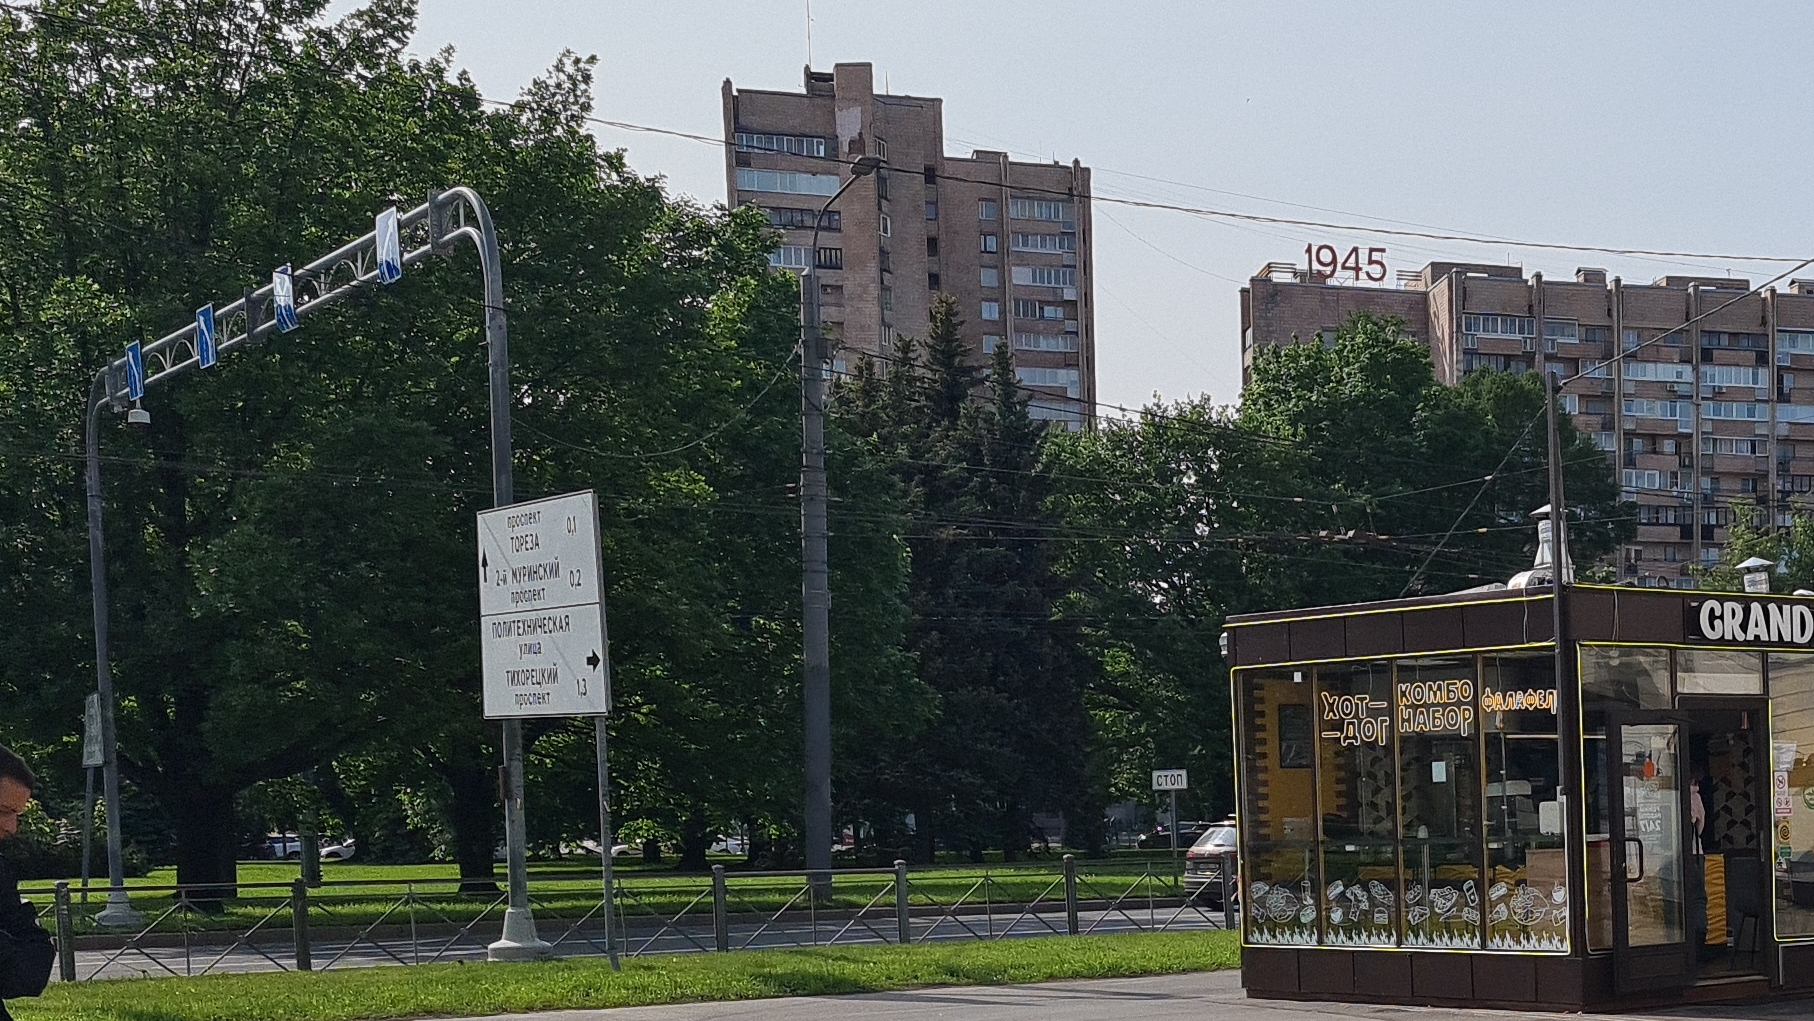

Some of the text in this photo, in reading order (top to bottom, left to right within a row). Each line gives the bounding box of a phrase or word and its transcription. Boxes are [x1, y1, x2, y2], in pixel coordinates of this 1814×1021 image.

[1305, 242, 1387, 283] 1945
[507, 510, 541, 532] проспект
[566, 515, 577, 536] 0,1
[510, 532, 540, 554] ТОРЕЗА
[495, 555, 560, 587] 2-й МУРИНСКИЙ
[569, 568, 582, 589] 0,2
[511, 587, 546, 608] проспект
[491, 614, 571, 639] ПОЛИТЕХНИЧЕСКАЯ
[1700, 599, 1814, 644] GRAND
[519, 641, 542, 660] улица
[505, 662, 559, 688] ТИХОРЕЦКИЙ
[576, 677, 588, 699] 1,3
[1397, 679, 1474, 706] КОМБО
[514, 692, 551, 710] проспект
[1481, 686, 1558, 715] ФАЛАФЕЛ
[1398, 705, 1474, 737] НАБОР
[1156, 774, 1183, 787] СТОП
